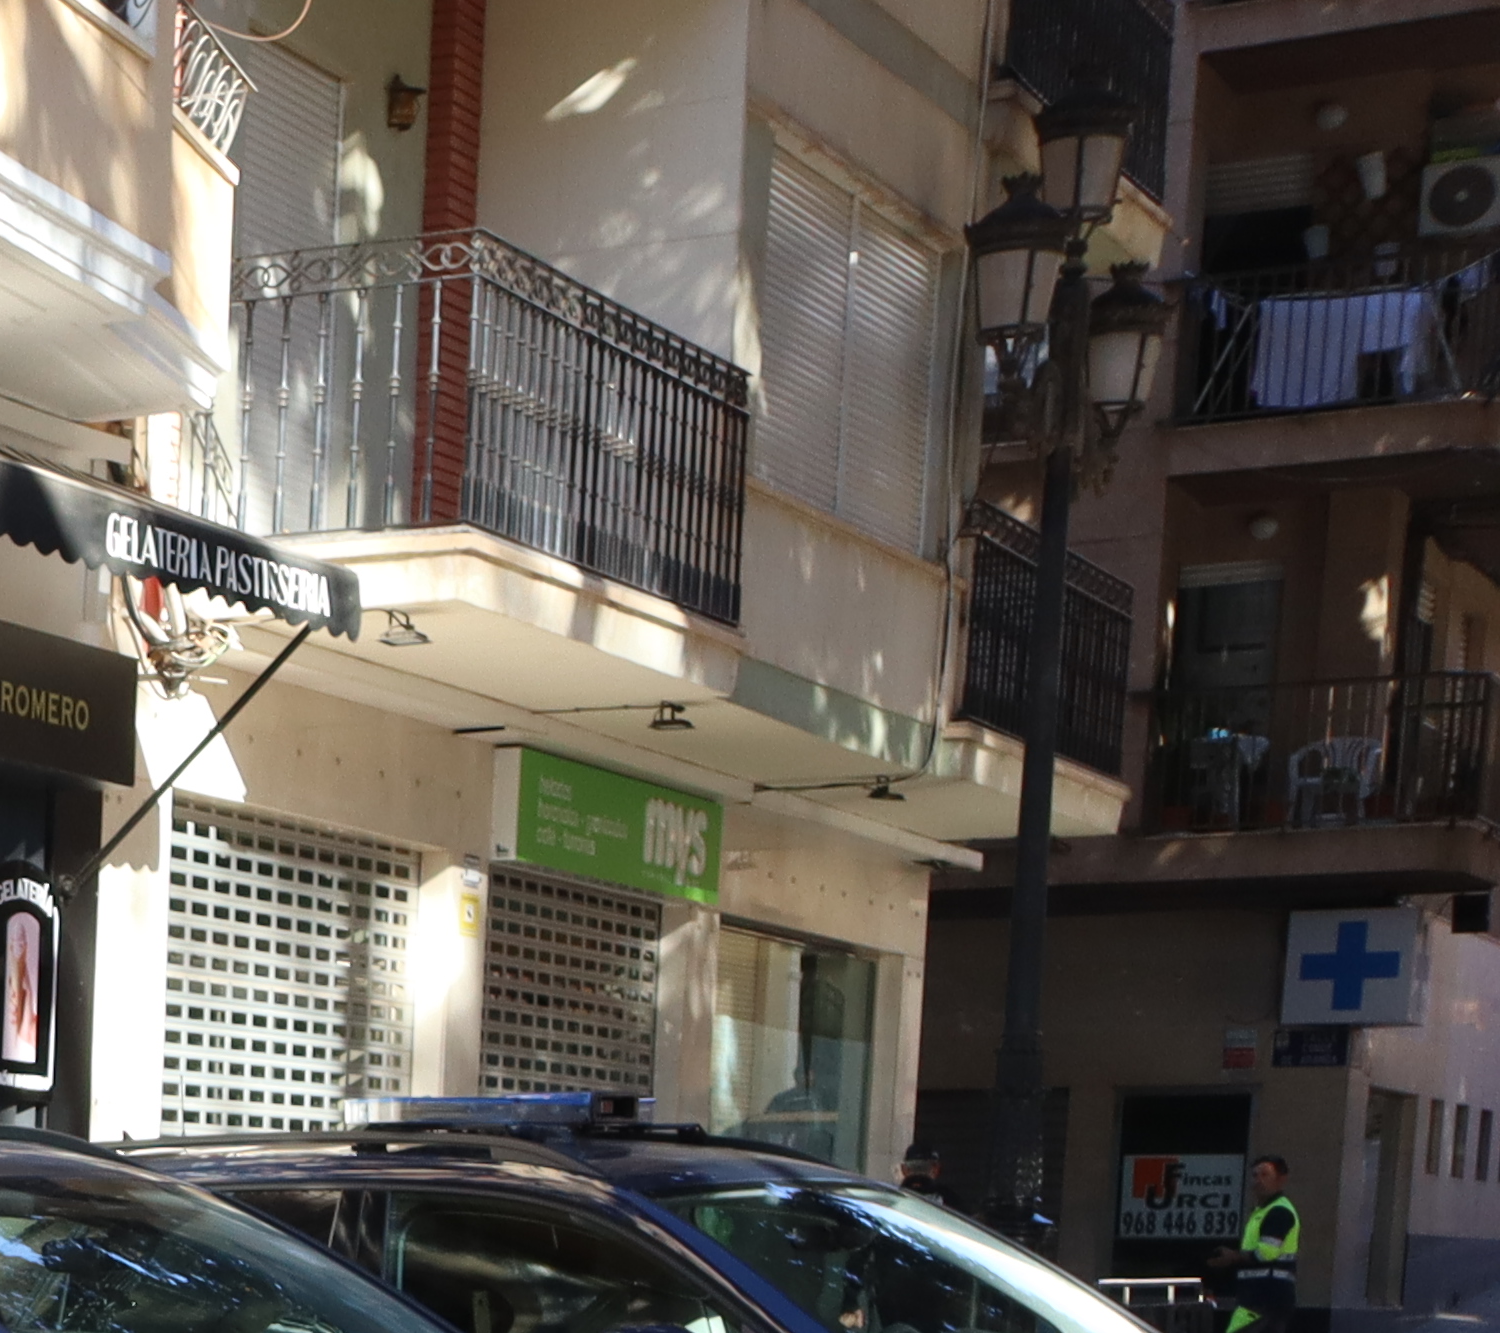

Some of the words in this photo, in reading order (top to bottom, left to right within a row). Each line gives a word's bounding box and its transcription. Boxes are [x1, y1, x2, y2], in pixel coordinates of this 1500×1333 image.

[105, 512, 212, 587] GELATERIA
[0, 680, 90, 731] ROMERO
[1122, 1211, 1157, 1236] 968
[1162, 1211, 1198, 1236] 446
[1203, 1210, 1240, 1236] 839
